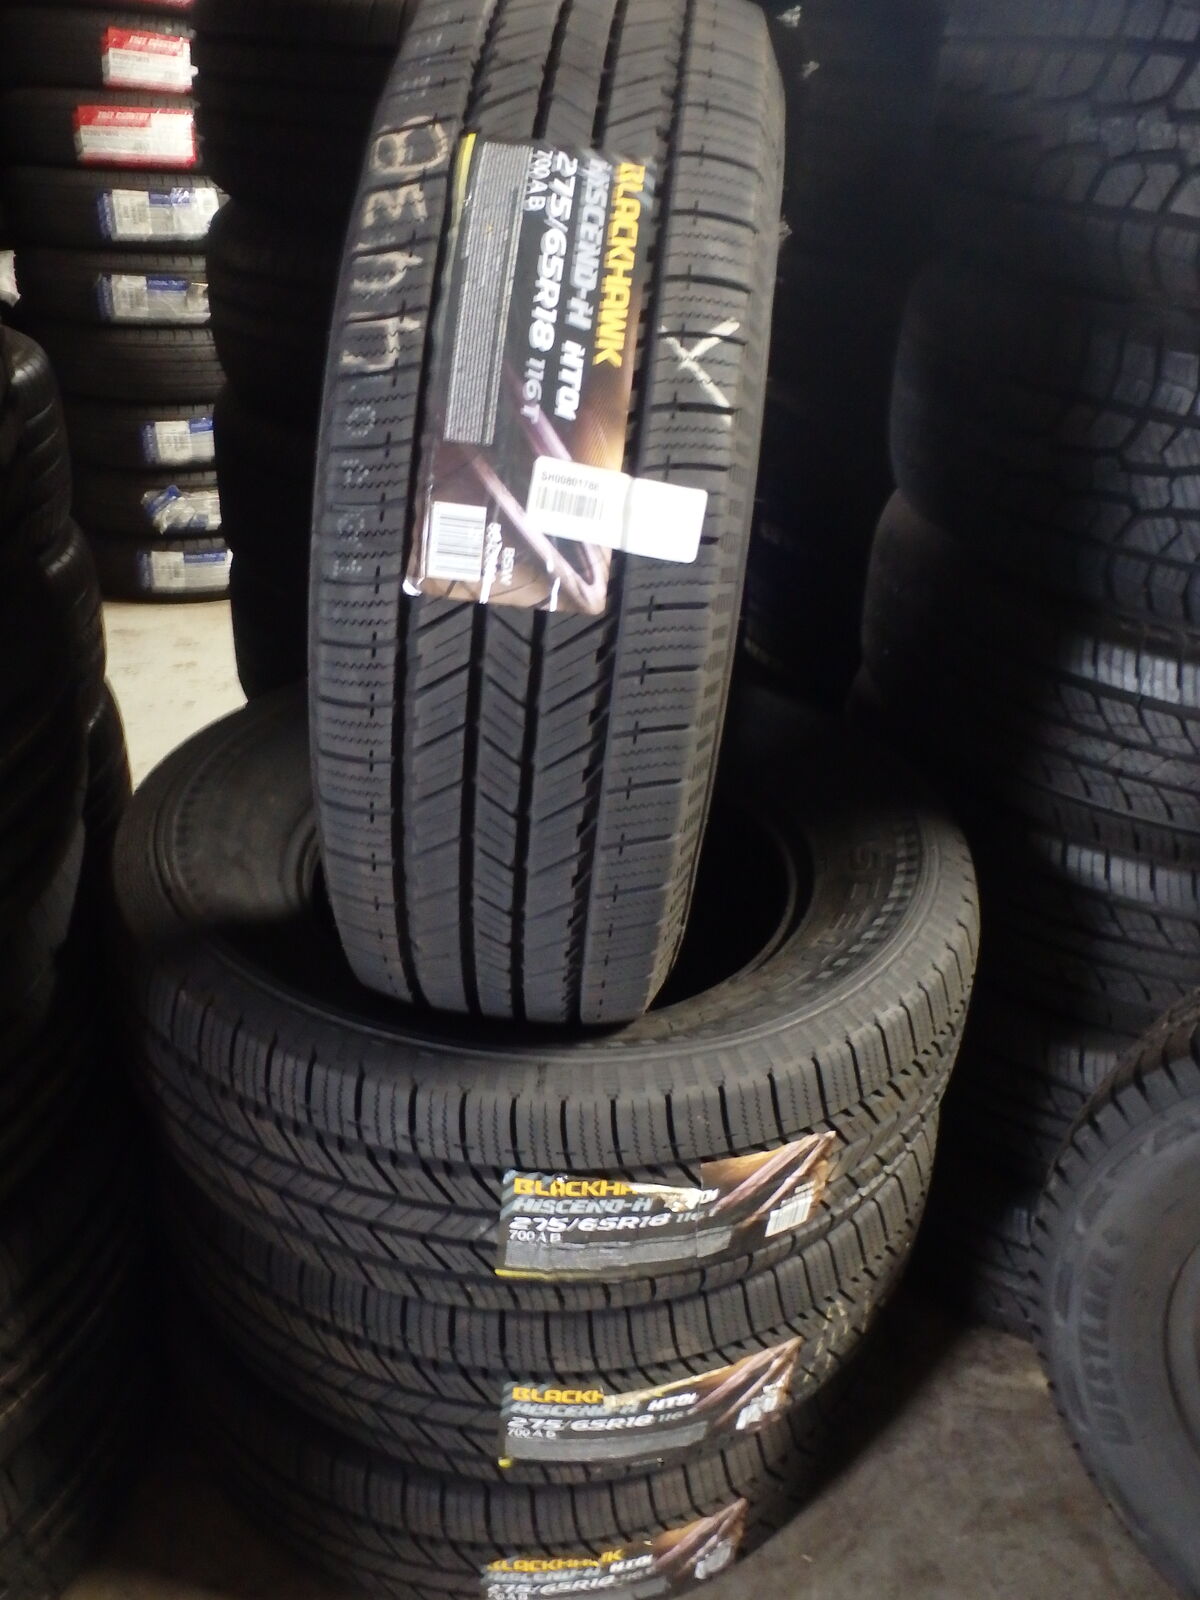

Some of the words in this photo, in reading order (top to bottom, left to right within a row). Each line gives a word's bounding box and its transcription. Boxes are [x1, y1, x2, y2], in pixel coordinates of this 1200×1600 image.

[529, 150, 578, 353] 275/65R18
[592, 161, 646, 368] BLACKHAWK
[508, 1212, 672, 1233] 275/65R18
[508, 1229, 535, 1242] 700
[536, 1231, 547, 1243] A
[549, 1232, 562, 1244] B
[507, 1414, 656, 1432] 275/65R18
